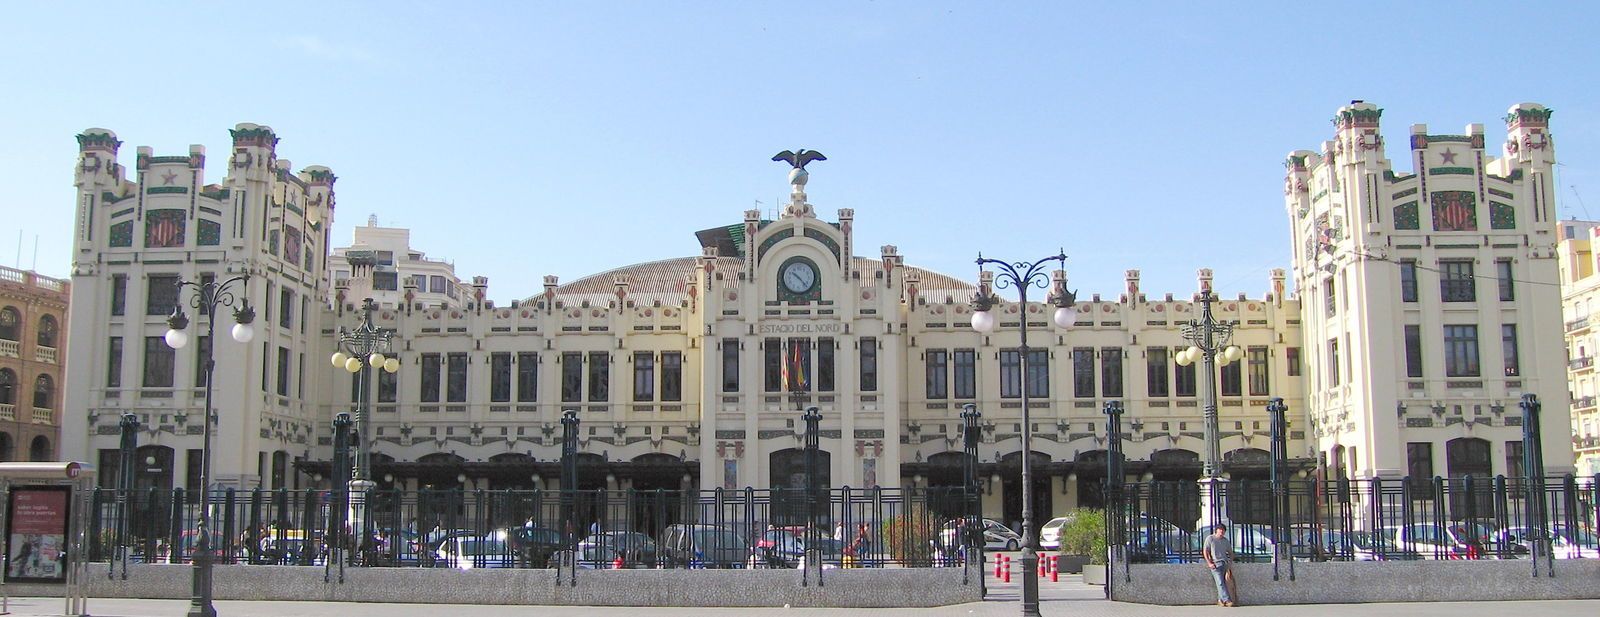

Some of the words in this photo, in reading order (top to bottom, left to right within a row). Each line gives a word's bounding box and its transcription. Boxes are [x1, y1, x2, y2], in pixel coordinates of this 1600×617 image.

[759, 323, 794, 333] ESTACIO
[796, 323, 814, 333] DEL
[815, 323, 840, 333] NORD
